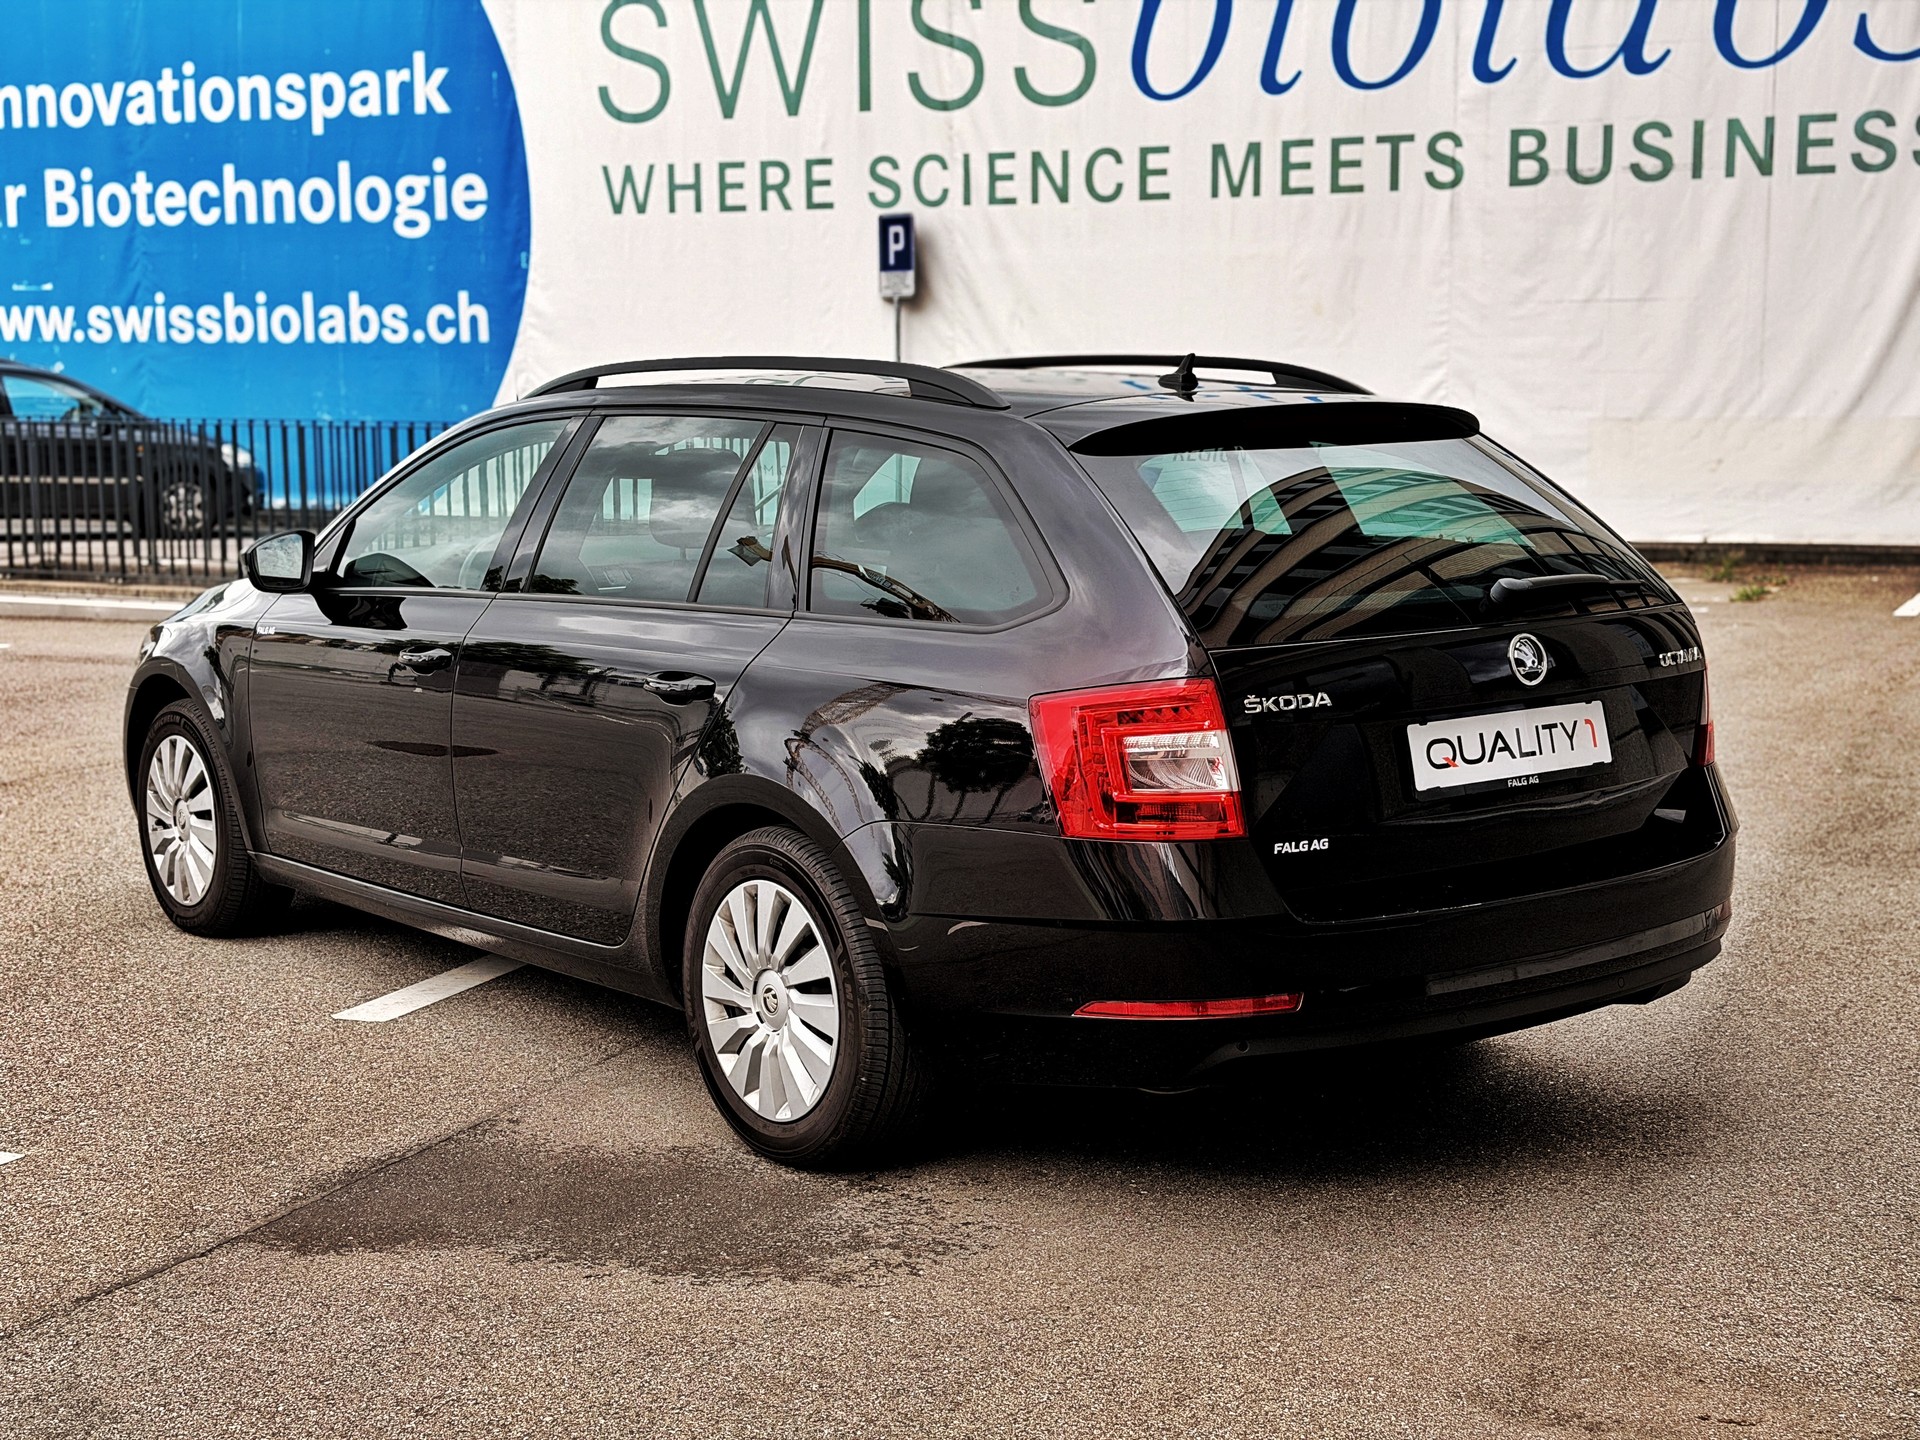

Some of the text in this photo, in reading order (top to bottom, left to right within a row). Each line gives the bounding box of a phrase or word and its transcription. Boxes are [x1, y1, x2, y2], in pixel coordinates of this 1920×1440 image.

[602, 109, 1920, 215] WHERE SCIENCE MEETS BUSINES
[44, 157, 489, 239] Biotechnologie
[888, 225, 905, 266] P
[1243, 692, 1332, 714] ŠKODA
[1507, 775, 1540, 788] FALG AG
[1273, 837, 1329, 855] FALG AG
